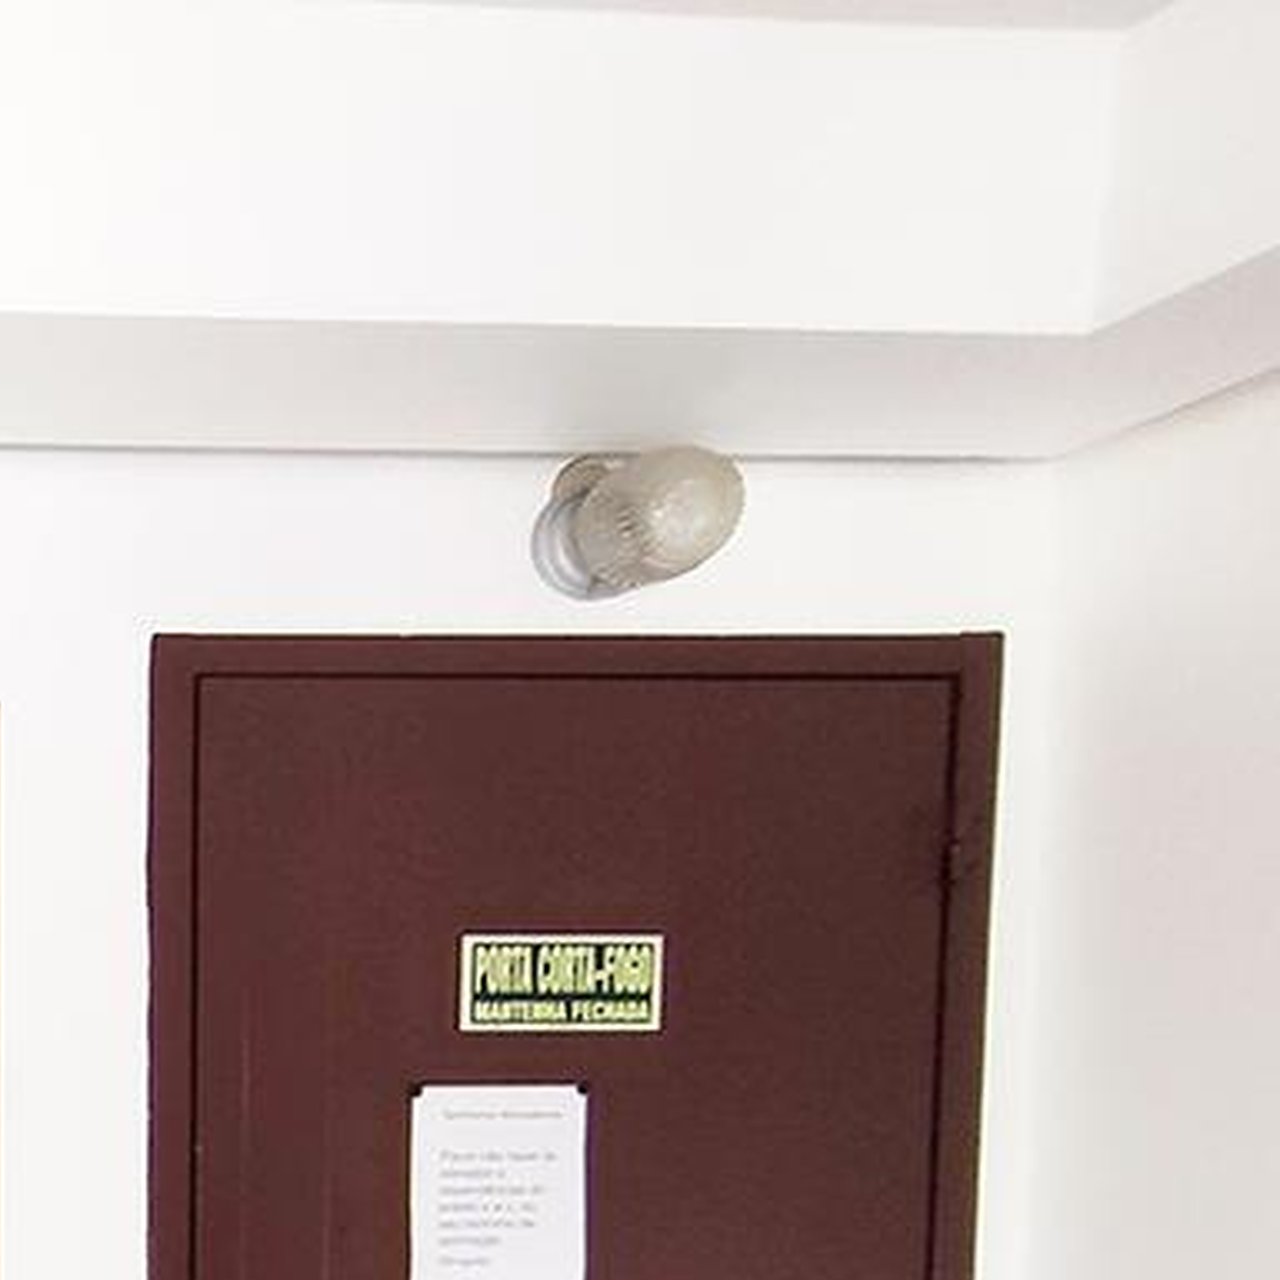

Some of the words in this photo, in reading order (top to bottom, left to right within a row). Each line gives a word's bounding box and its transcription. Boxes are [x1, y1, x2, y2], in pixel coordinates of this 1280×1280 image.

[474, 944, 534, 994] PORTA
[537, 944, 653, 994] CORTA-FOGO
[473, 999, 568, 1022] MANTENHA
[570, 999, 650, 1022] FECHADA
